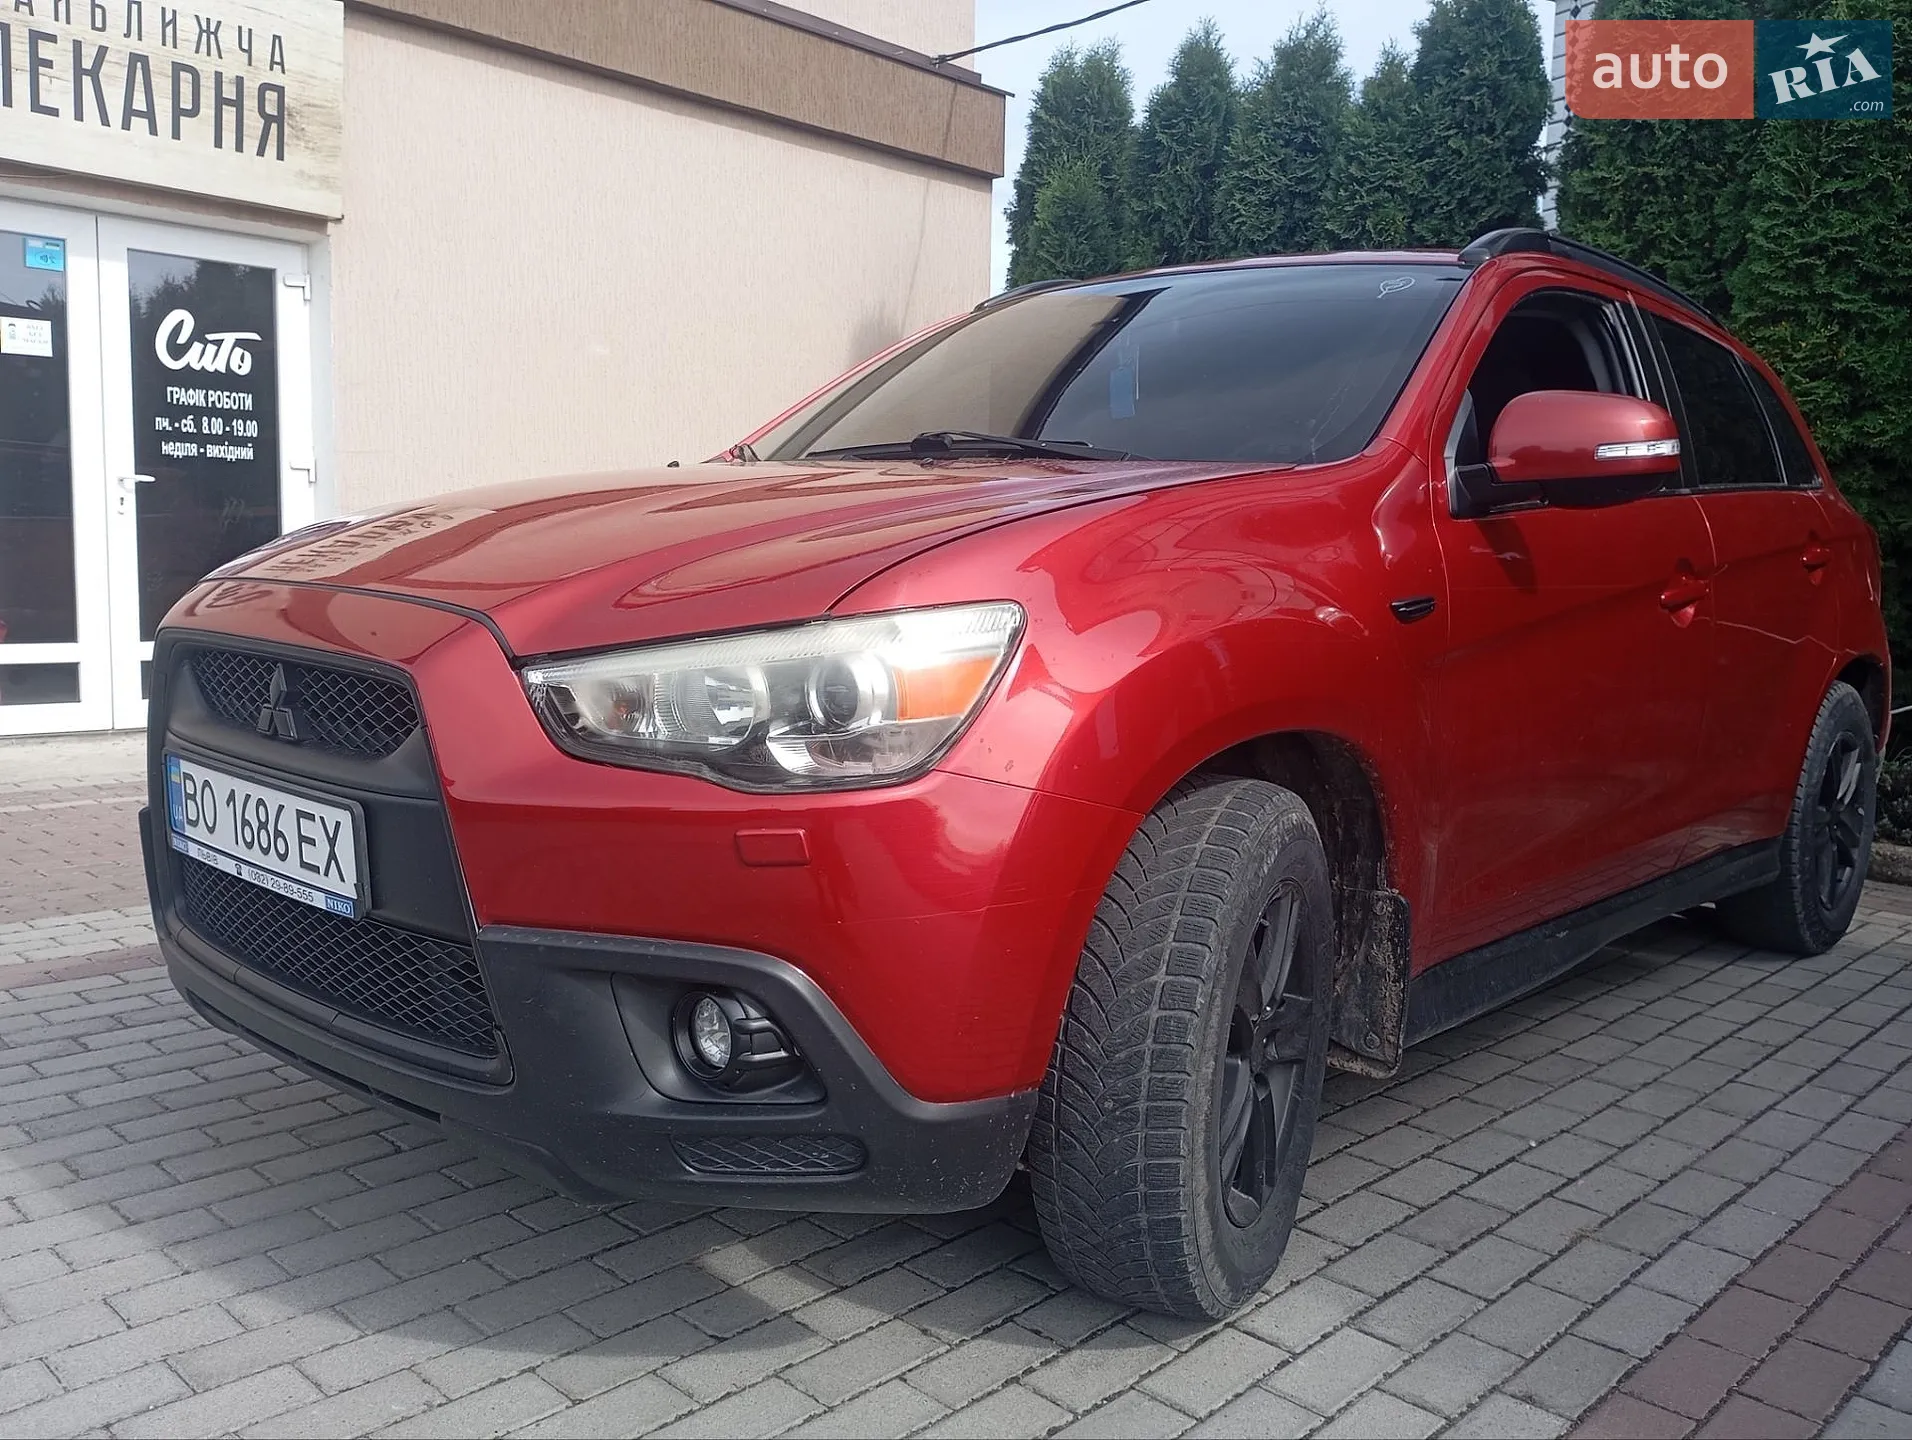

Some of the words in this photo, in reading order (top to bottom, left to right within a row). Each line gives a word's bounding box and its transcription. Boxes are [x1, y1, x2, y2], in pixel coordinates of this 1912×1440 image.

[166, 386, 206, 407] ГРАФІК
[207, 390, 253, 411] РОБОТИ
[181, 415, 197, 433] сб.
[201, 416, 223, 435] 8.00
[232, 418, 258, 437] 19.00
[206, 441, 254, 461] вихідний
[172, 803, 183, 822] UA
[182, 771, 218, 835] BO
[225, 788, 290, 862] 1686
[295, 808, 346, 884] EX
[248, 868, 269, 886] (032)
[270, 877, 314, 902] 29-89-555
[326, 898, 351, 914] NIKO
